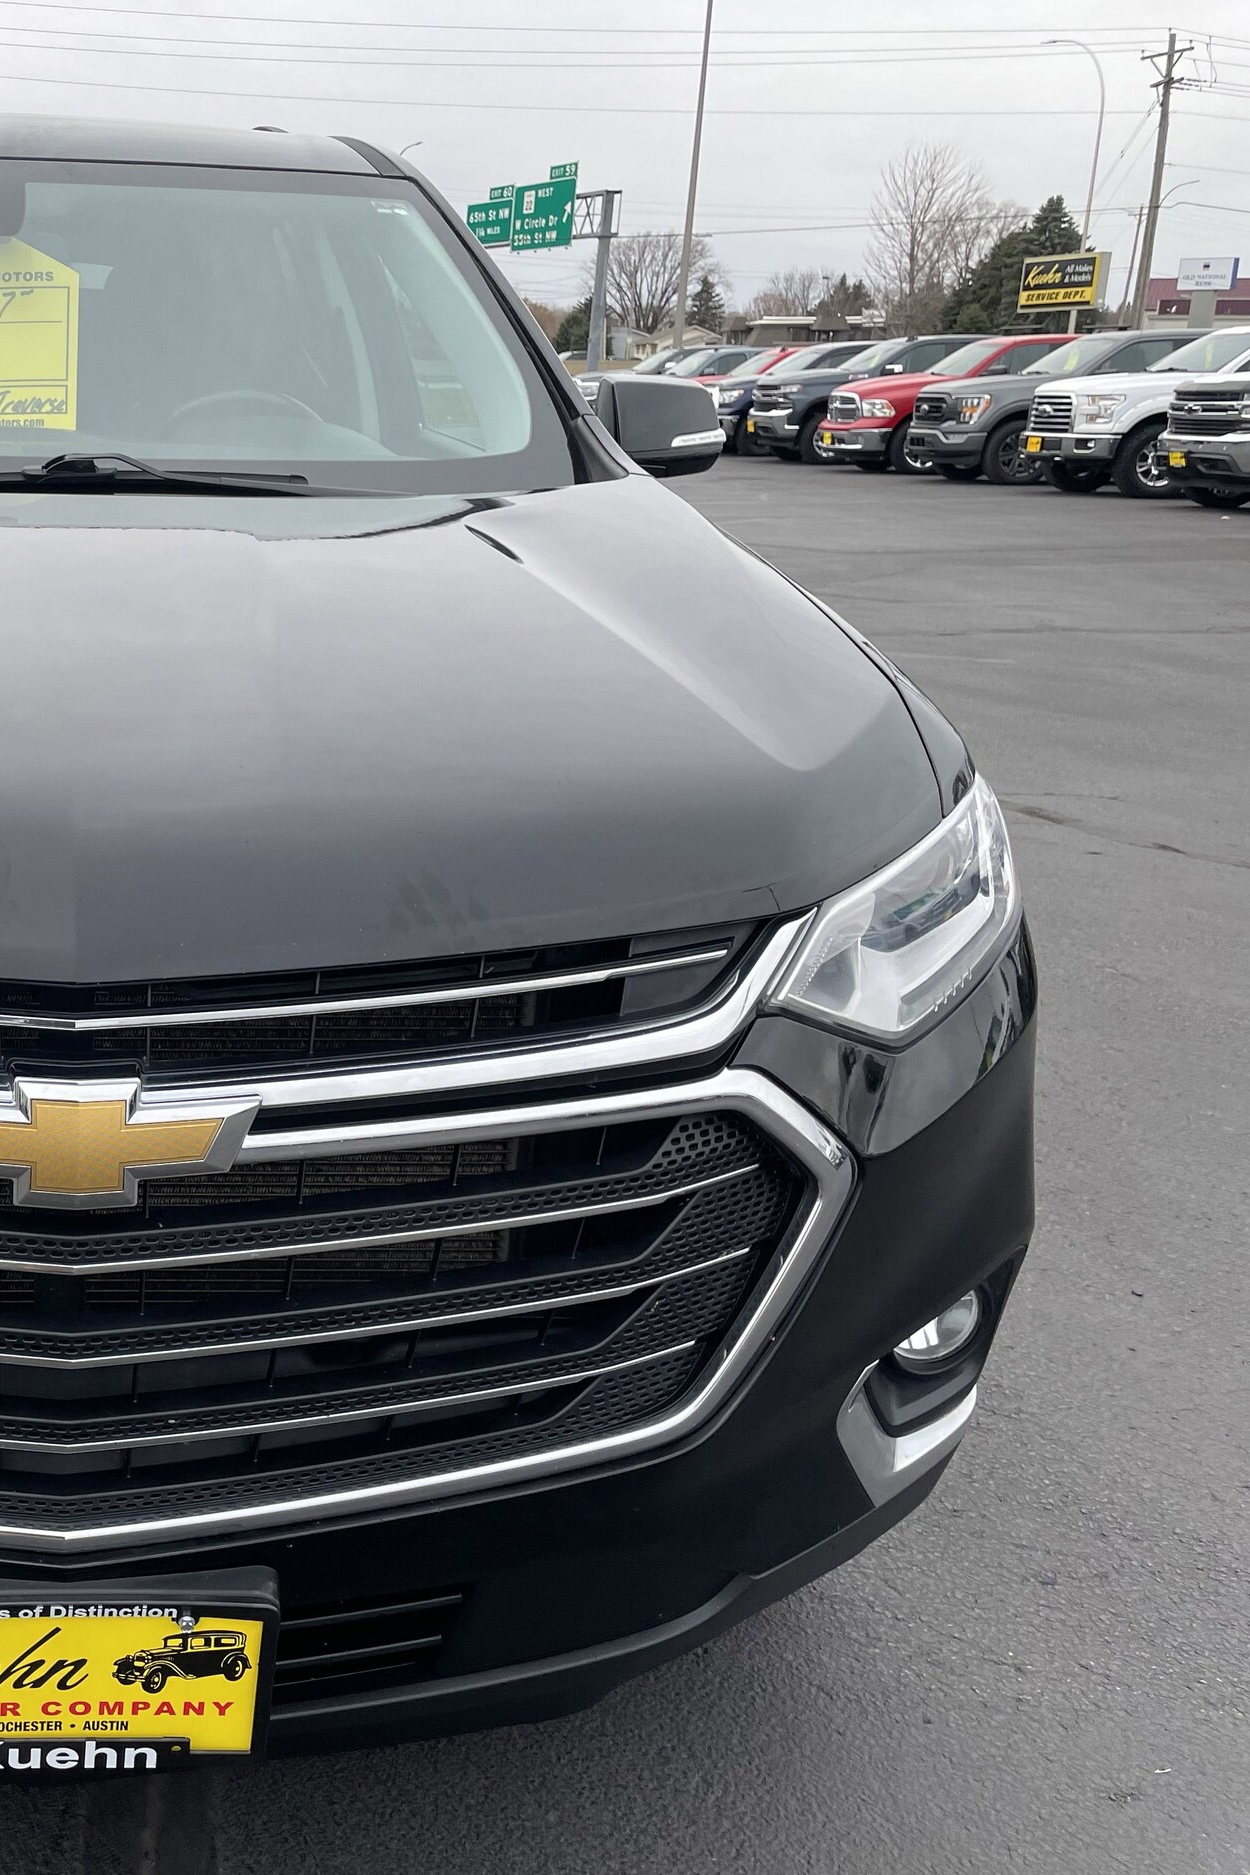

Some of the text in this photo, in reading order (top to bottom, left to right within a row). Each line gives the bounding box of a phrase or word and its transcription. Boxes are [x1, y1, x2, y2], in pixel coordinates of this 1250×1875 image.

[552, 164, 576, 177] EXIT 59
[491, 186, 512, 198] EXIT 60
[538, 187, 554, 198] WEST
[525, 200, 533, 211] 22
[469, 207, 510, 224] 65th St NW
[515, 214, 558, 231] W Circle Dr
[513, 230, 557, 246] 55th St NW
[1065, 264, 1075, 273] All
[1024, 263, 1062, 287] Kuehn
[1071, 272, 1091, 283] Models
[1025, 290, 1086, 302] SERVICE DEPT.
[18, 1606, 44, 1620] of
[50, 1605, 178, 1618] Distinction
[41, 1701, 235, 1717] COMPANY
[82, 1720, 129, 1731] AUSTIN
